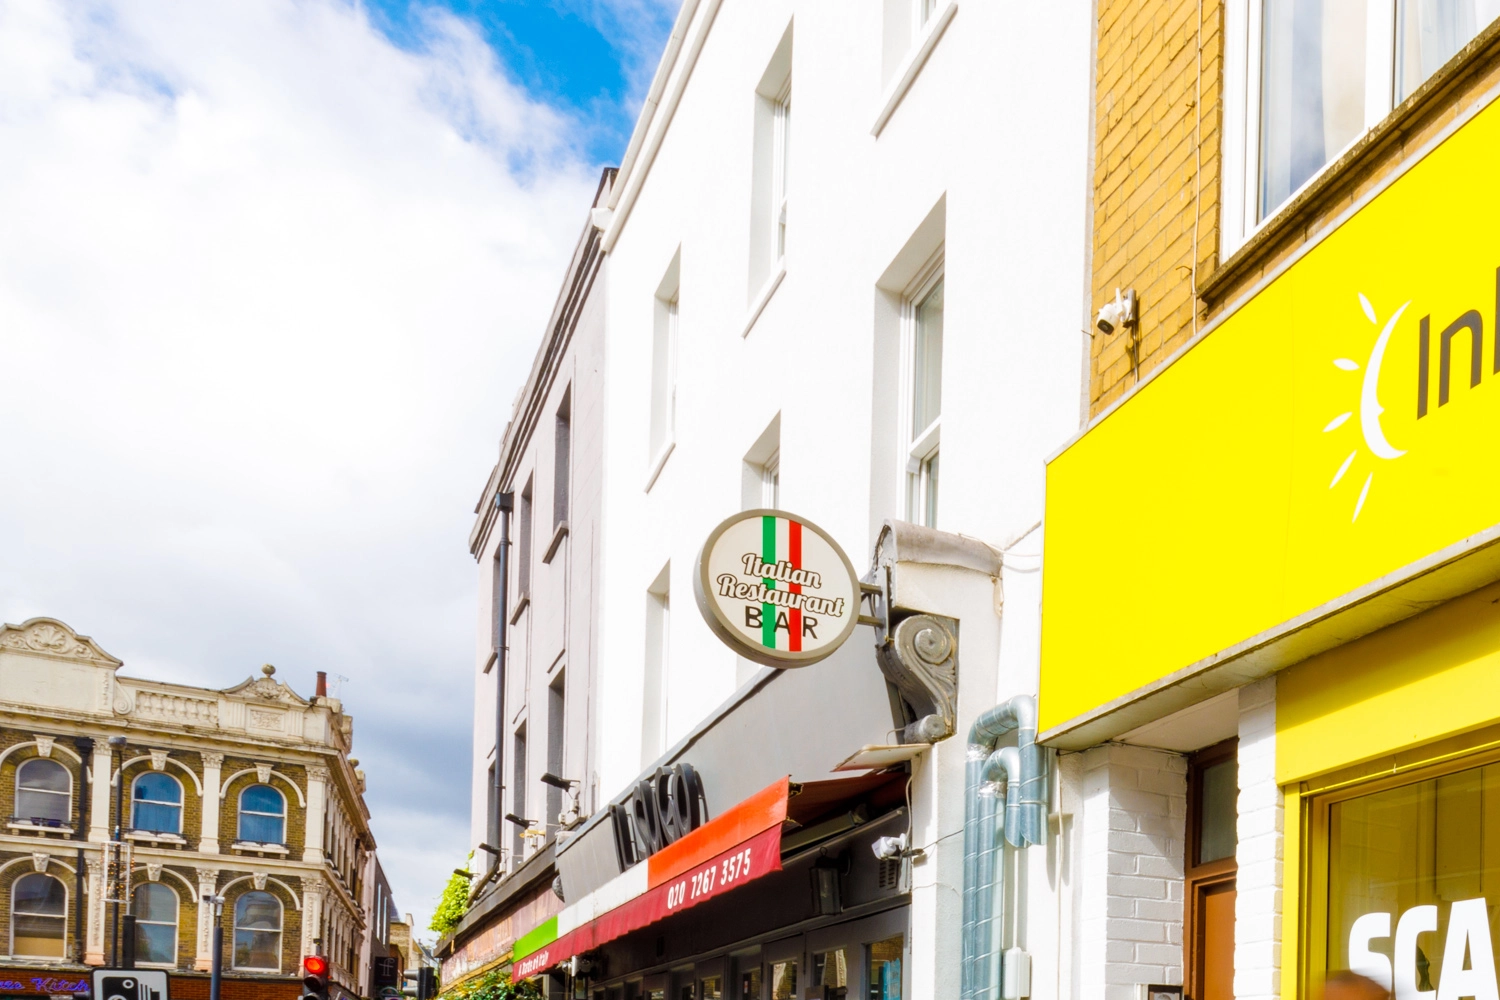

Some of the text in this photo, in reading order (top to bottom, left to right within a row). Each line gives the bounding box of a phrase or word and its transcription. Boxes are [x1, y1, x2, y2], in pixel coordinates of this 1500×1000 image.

[742, 553, 822, 589] Italian
[717, 574, 844, 617] Restaurant
[745, 606, 818, 639] BAR
[667, 848, 751, 909] 020 7267 3575
[31, 977, 90, 993] Kitch
